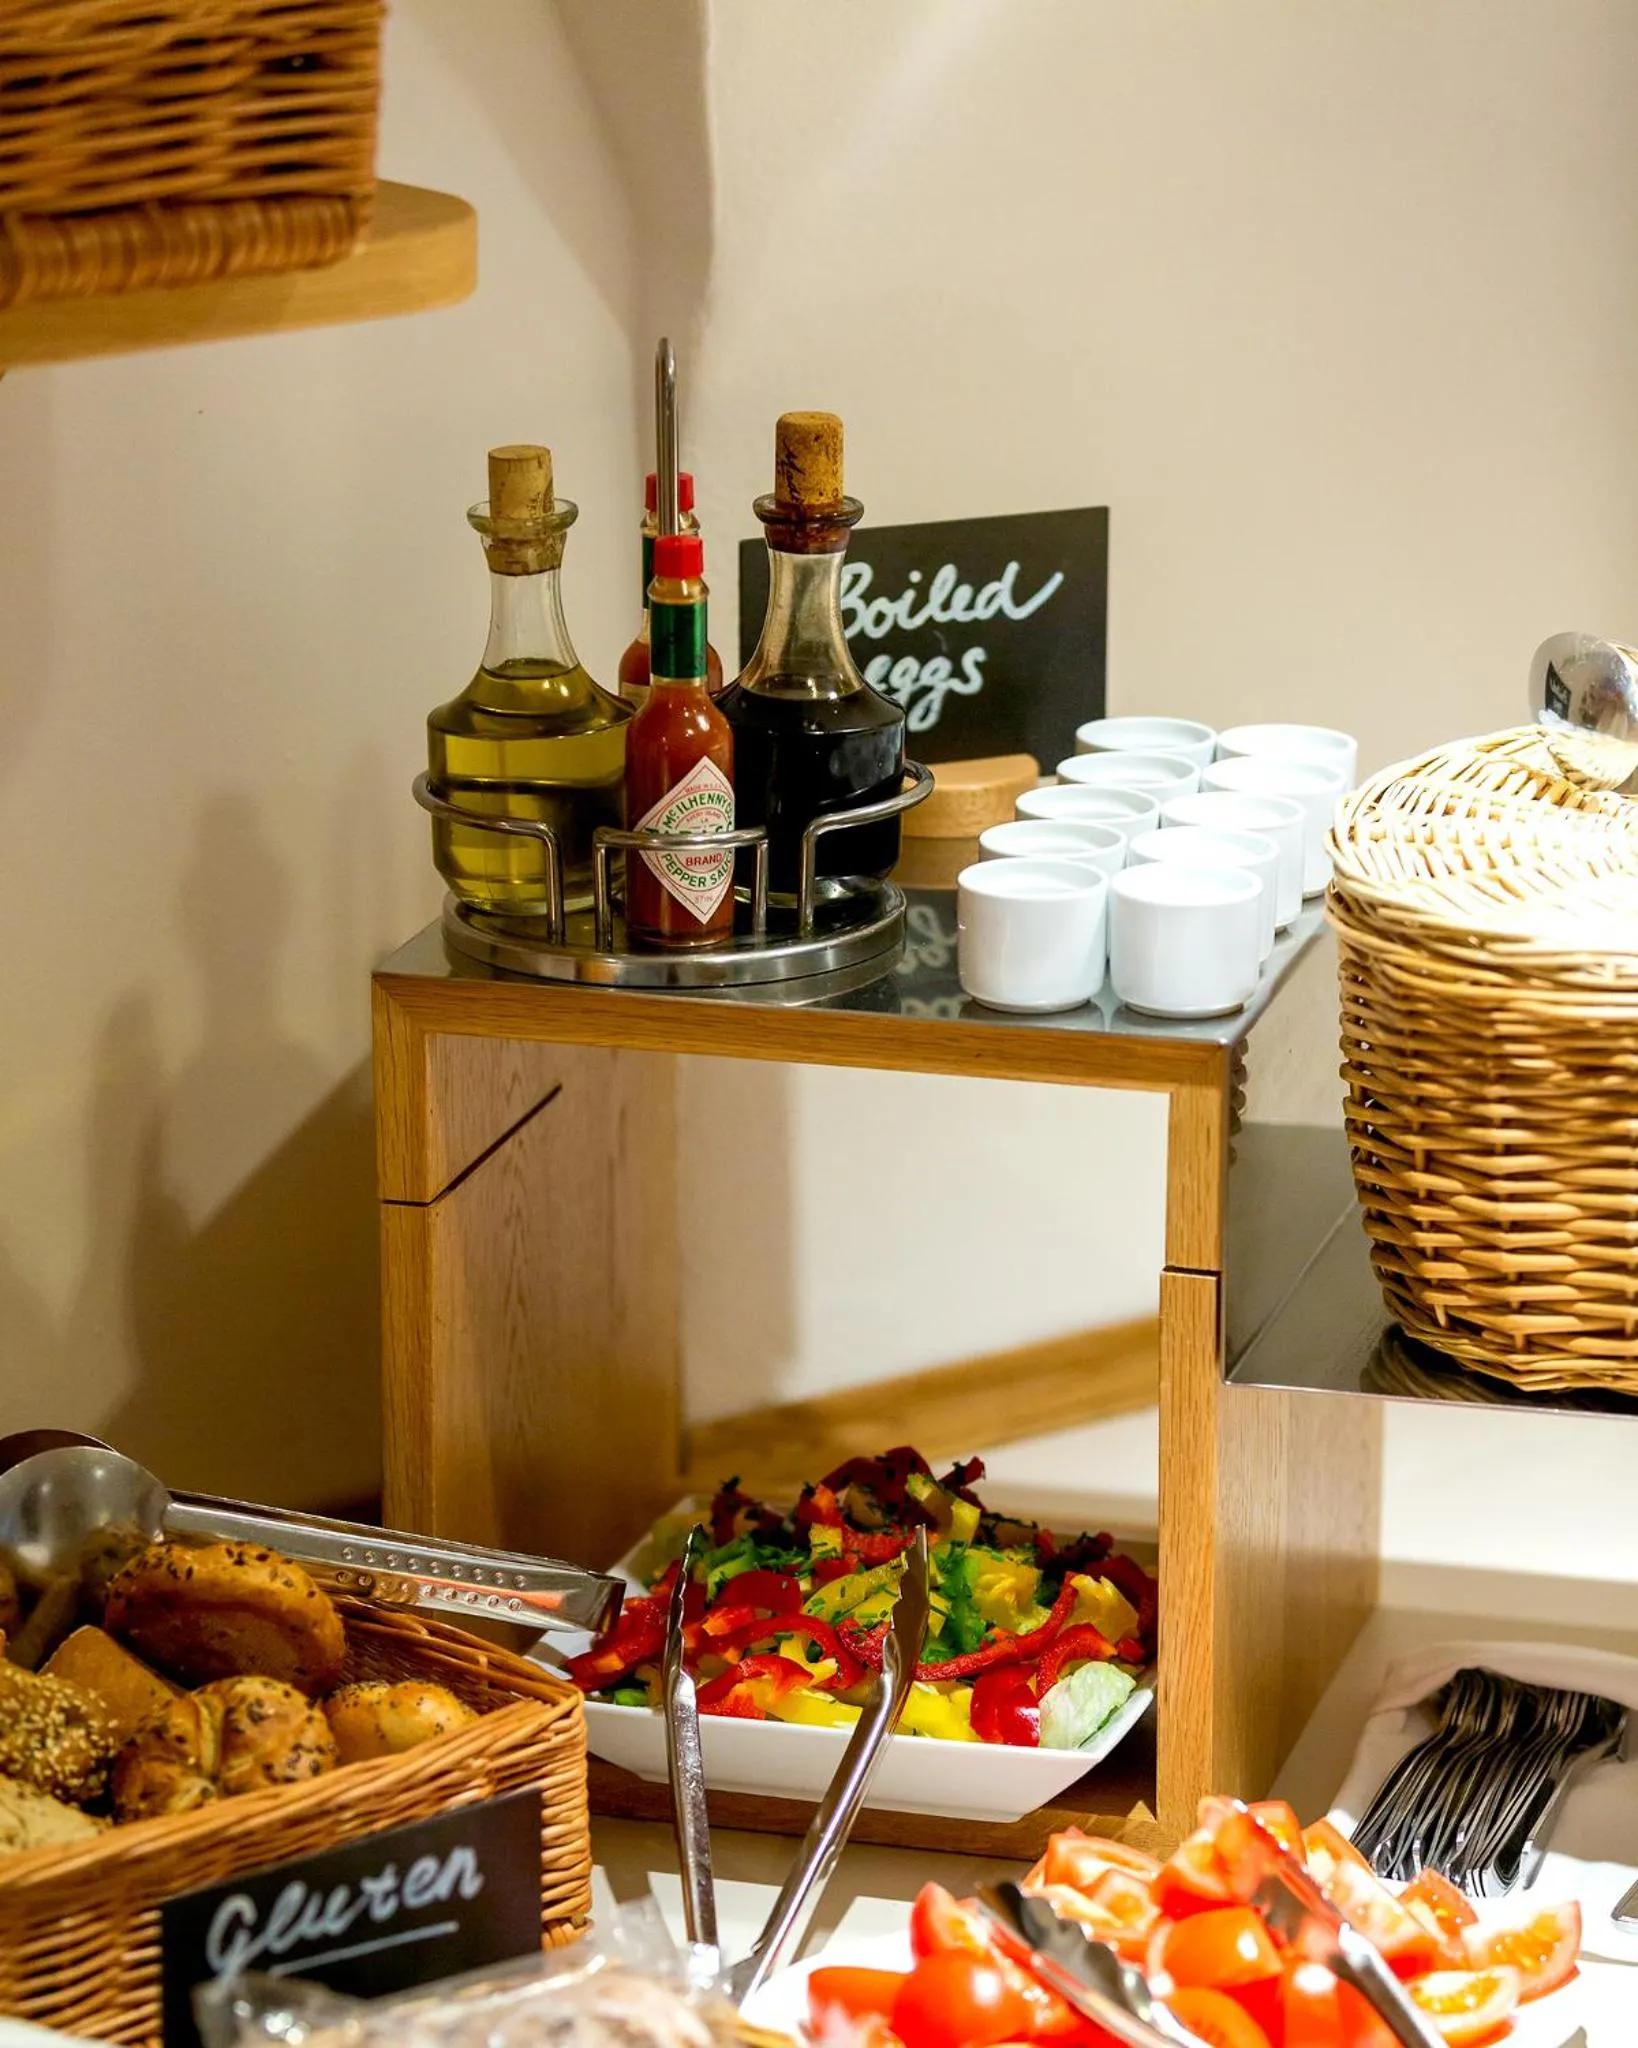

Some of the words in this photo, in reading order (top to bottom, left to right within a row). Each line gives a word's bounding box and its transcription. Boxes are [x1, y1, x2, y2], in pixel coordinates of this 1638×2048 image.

[841, 560, 1064, 640] Boiled
[864, 646, 987, 732] eggs
[661, 853, 707, 888] PEPPER
[685, 852, 723, 867] BRAND
[205, 1845, 484, 2002] Gluten
